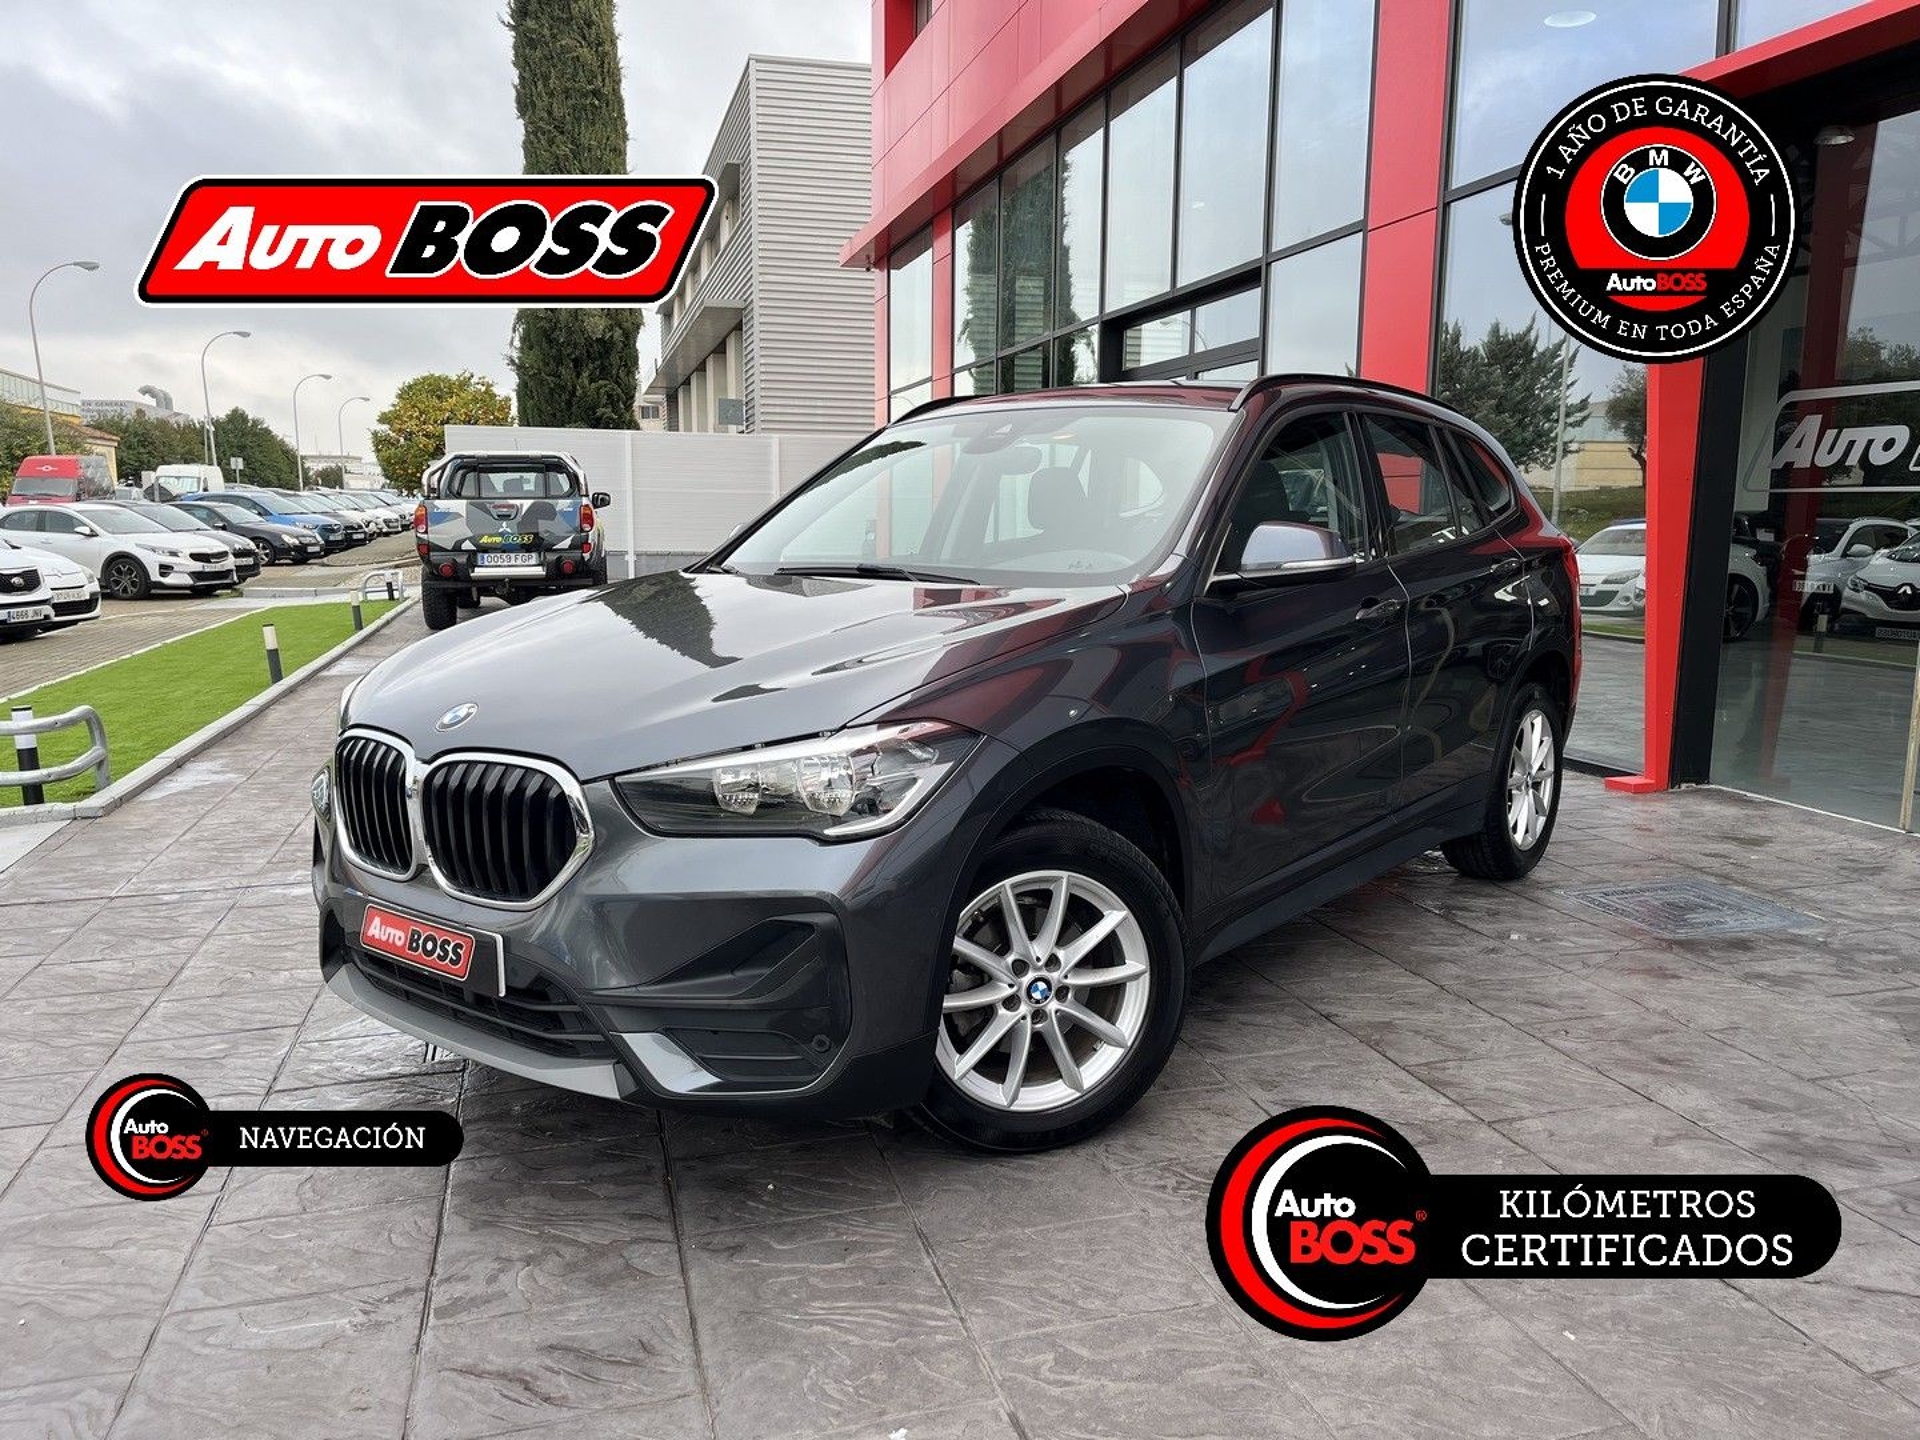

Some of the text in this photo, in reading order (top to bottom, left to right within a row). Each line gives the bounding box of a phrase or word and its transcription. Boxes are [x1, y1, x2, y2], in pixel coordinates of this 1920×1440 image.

[486, 554, 534, 564] 0059 FGP
[407, 928, 466, 968] BOSS
